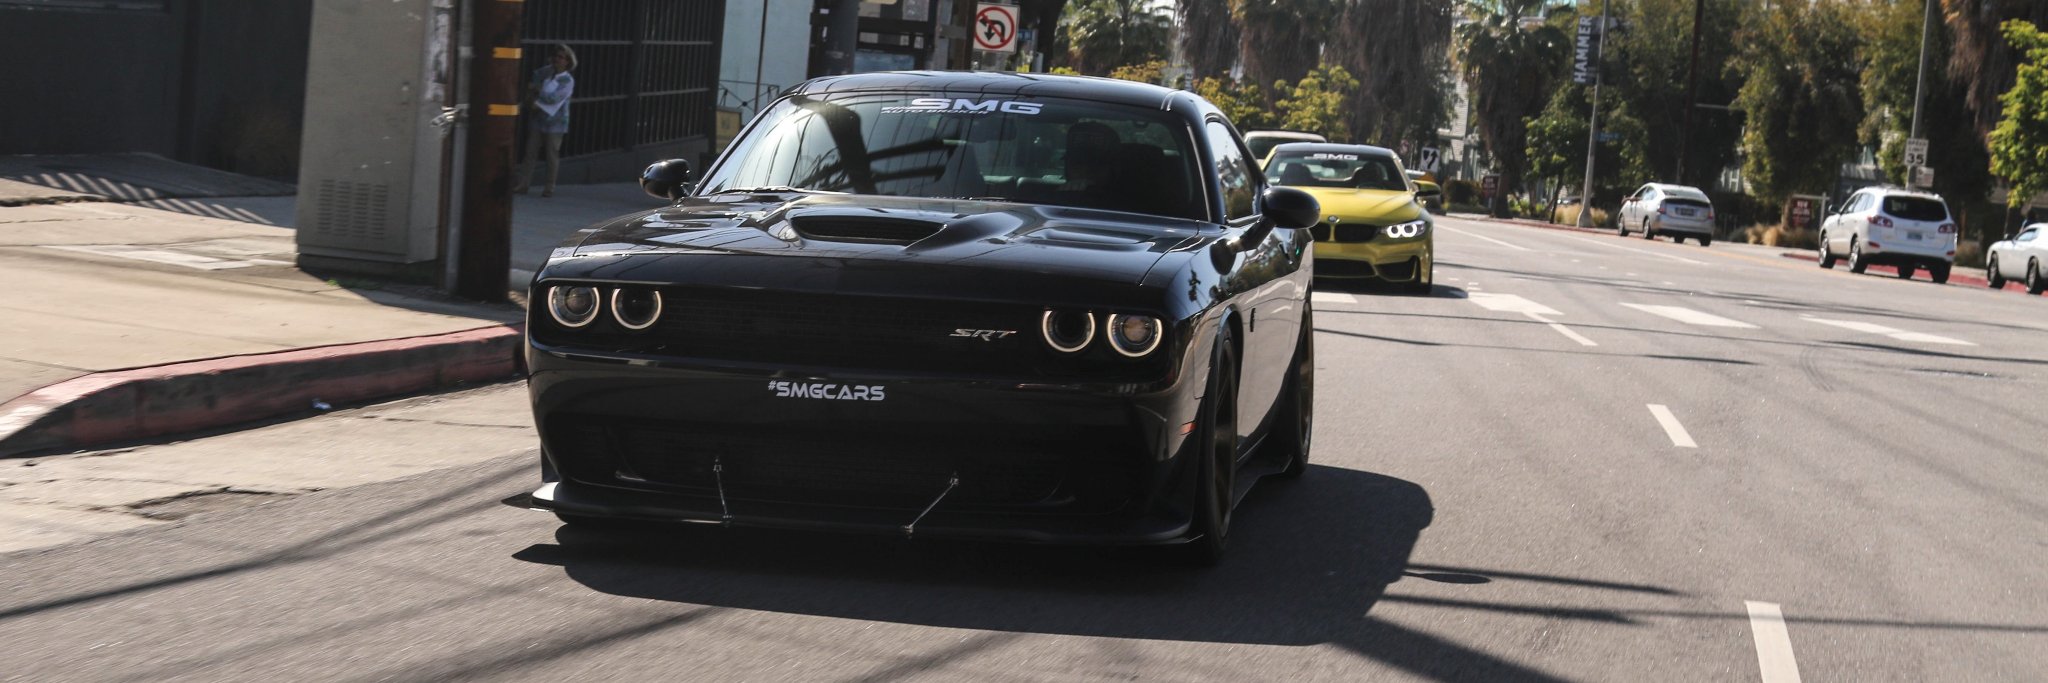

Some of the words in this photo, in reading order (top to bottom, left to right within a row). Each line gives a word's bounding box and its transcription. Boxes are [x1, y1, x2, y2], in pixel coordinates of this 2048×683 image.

[1573, 15, 1593, 83] HAMMER
[911, 98, 1044, 115] SMG
[1313, 153, 1358, 161] SMG
[1906, 152, 1924, 165] 35
[948, 328, 1017, 341] SRT
[768, 380, 885, 401] #SMGCARS
